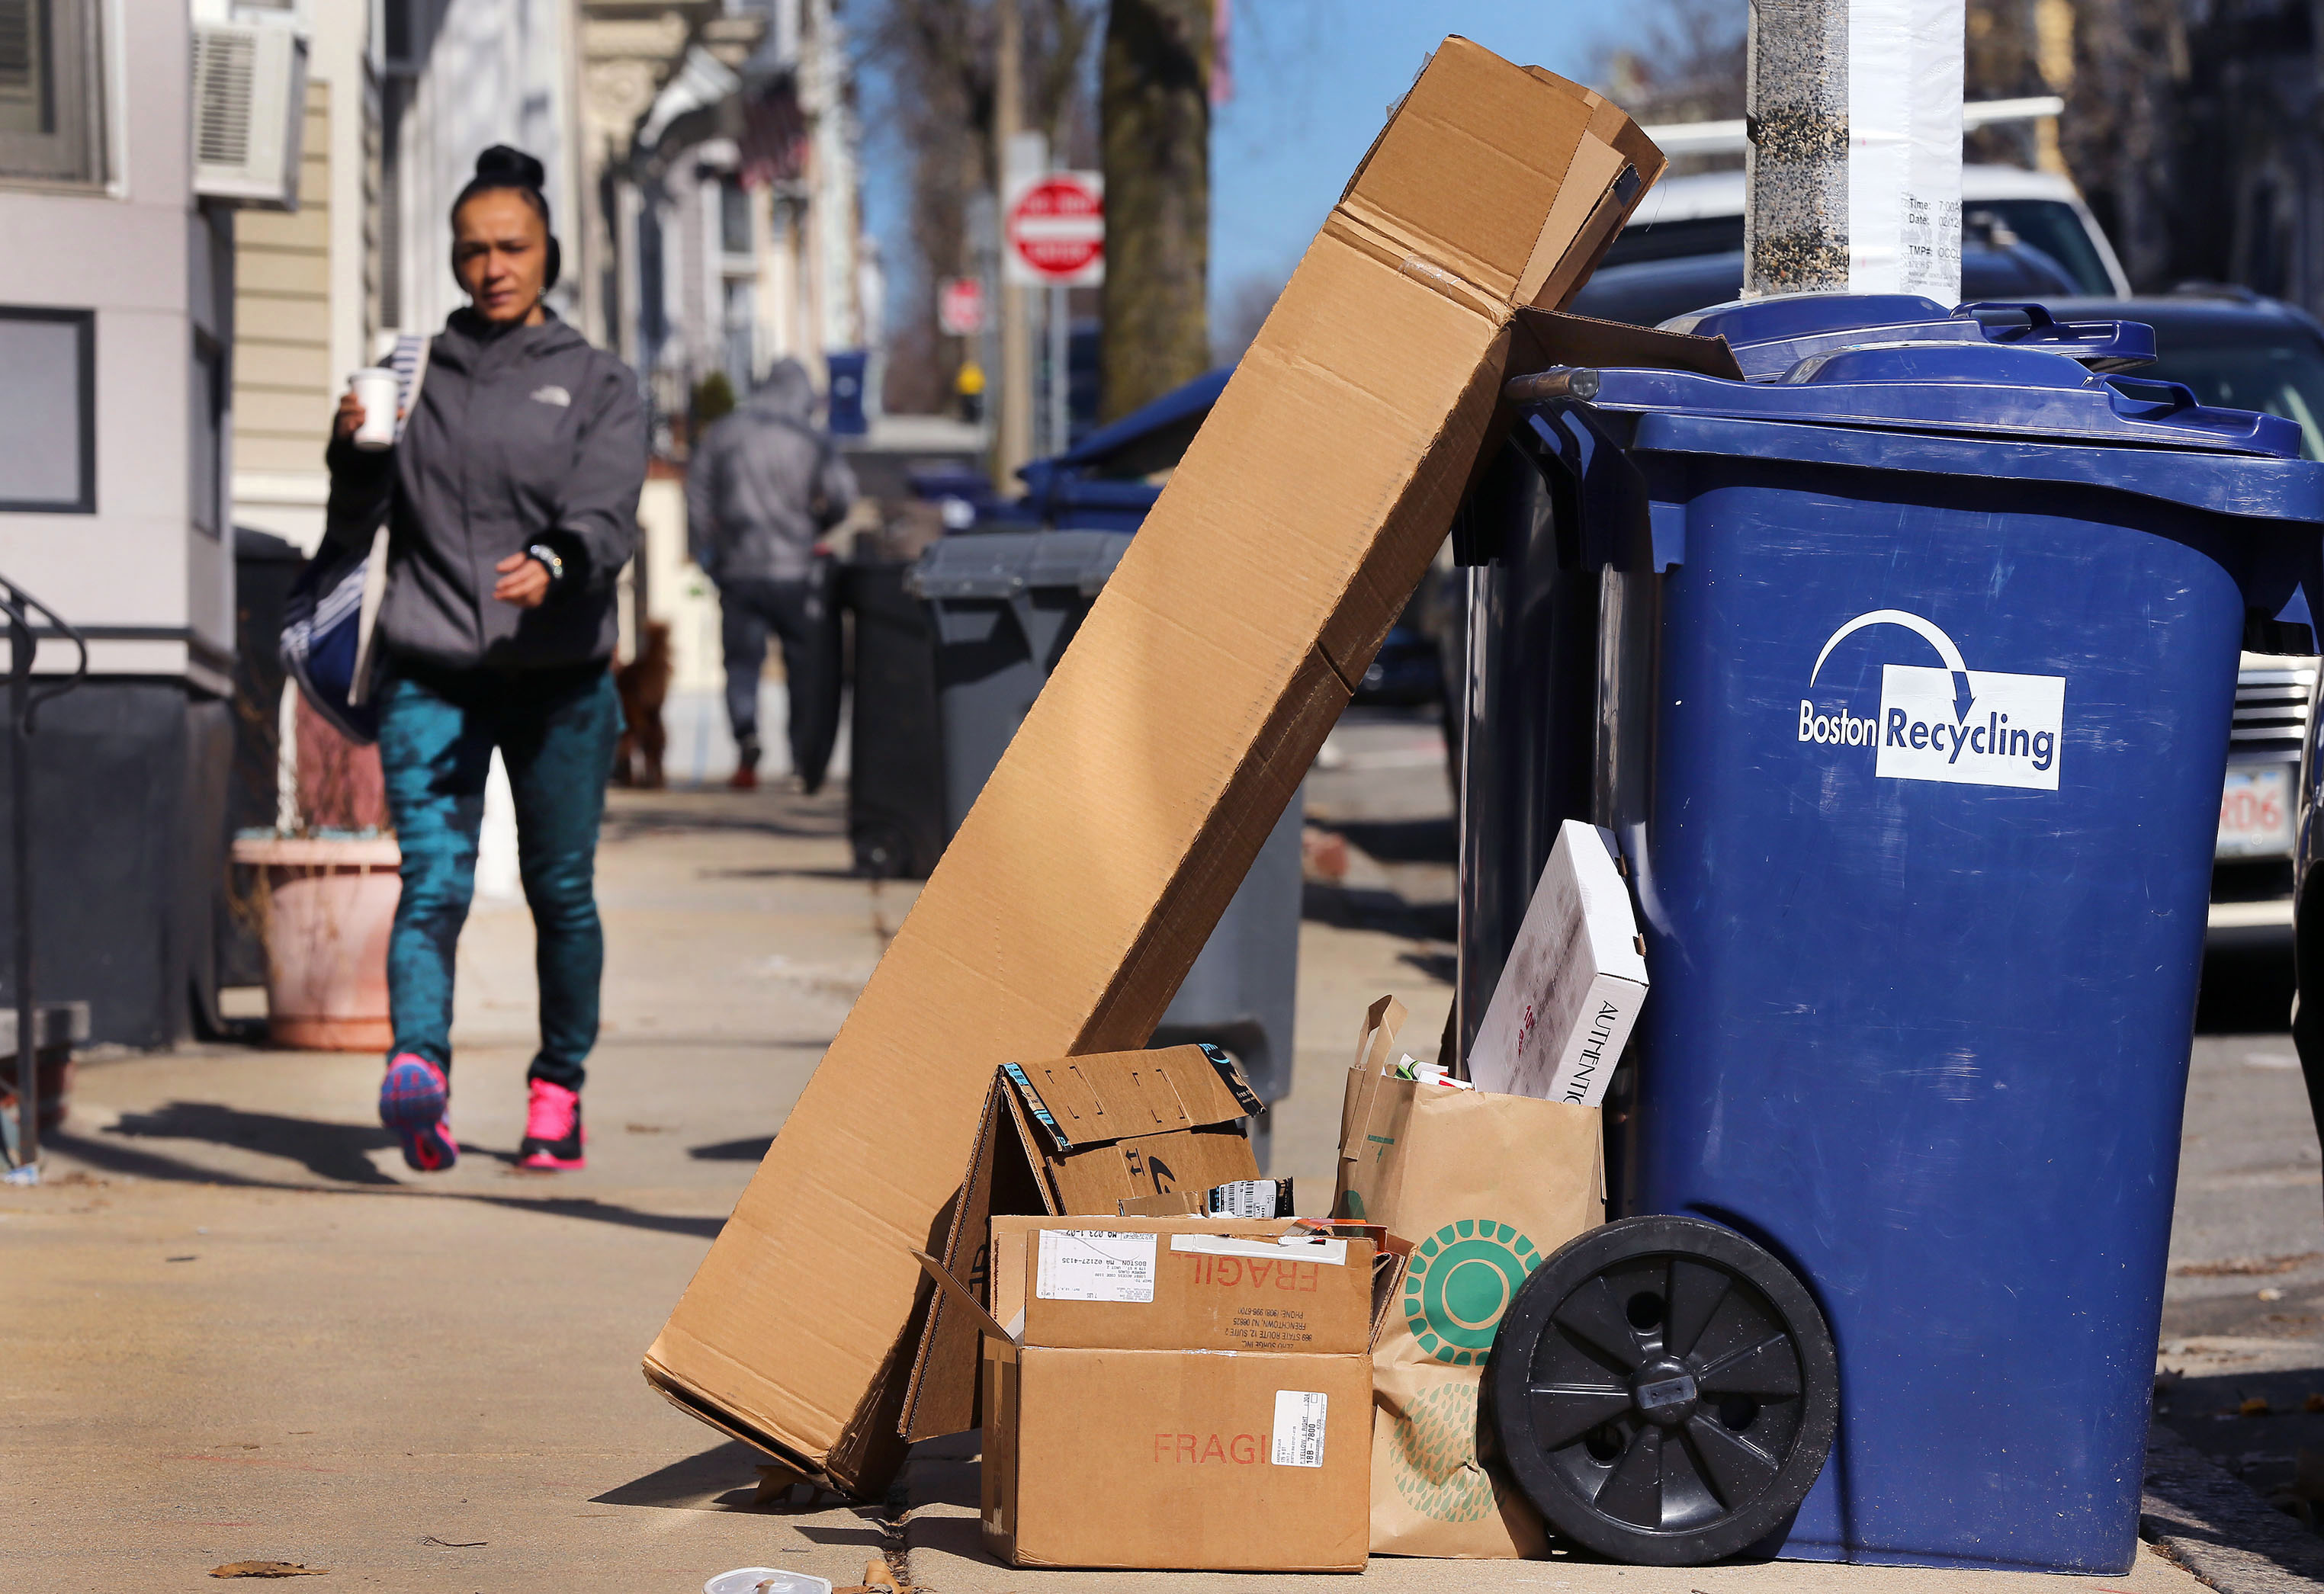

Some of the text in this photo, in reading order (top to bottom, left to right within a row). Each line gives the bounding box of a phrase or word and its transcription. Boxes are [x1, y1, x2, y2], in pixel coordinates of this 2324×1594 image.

[1909, 198, 1931, 210] Time:
[1909, 213, 1930, 226] Date:
[1797, 699, 2054, 770] Boston Recycling
[1168, 1252, 1318, 1292] FRAGIL
[1280, 1310, 1304, 1319] PHONE:
[1261, 1320, 1306, 1330] FRENCHTOWN,
[1230, 1329, 1248, 1337] SUITE
[1260, 1330, 1280, 1339] ROUTE
[1282, 1333, 1301, 1341] STATE
[1307, 1423, 1316, 1442] 7800
[1154, 1433, 1266, 1464] FRAGI
